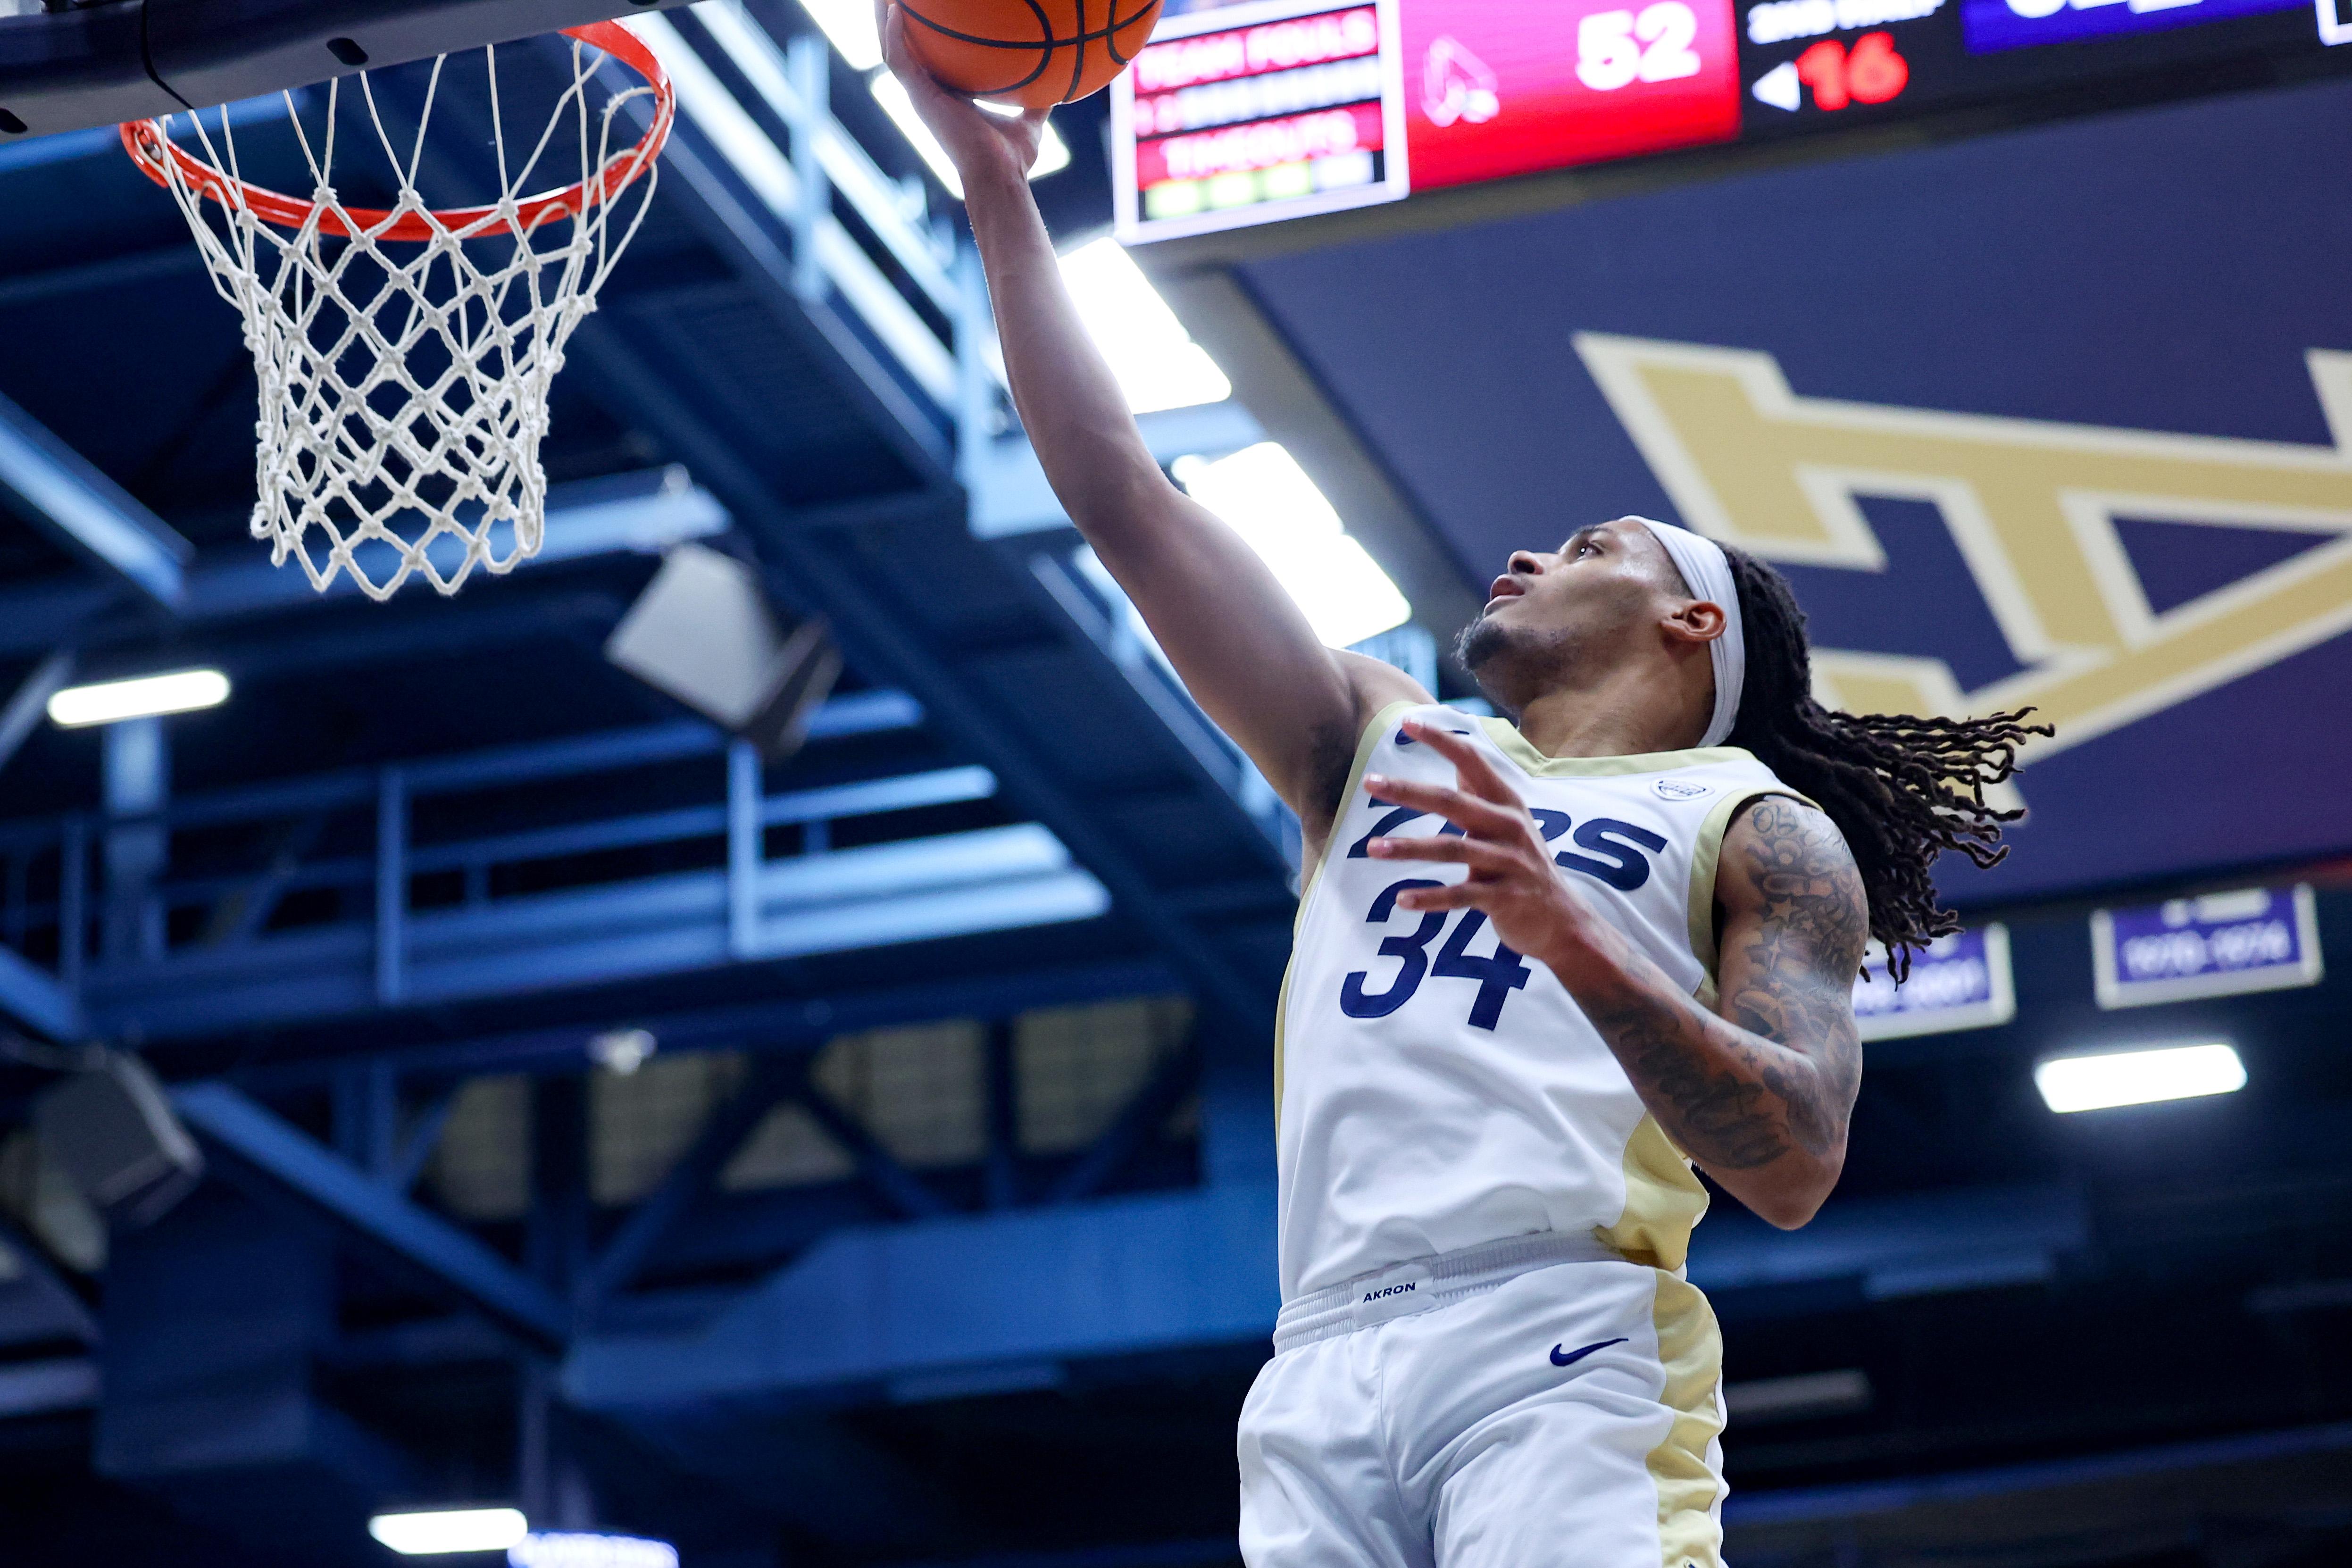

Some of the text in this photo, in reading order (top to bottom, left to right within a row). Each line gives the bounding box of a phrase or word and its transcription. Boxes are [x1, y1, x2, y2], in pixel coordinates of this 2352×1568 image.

[1576, 1, 1701, 91] 52
[1795, 31, 1909, 111] 16
[1340, 879, 1531, 1031] 34
[1363, 1282, 1416, 1303] AKRON
